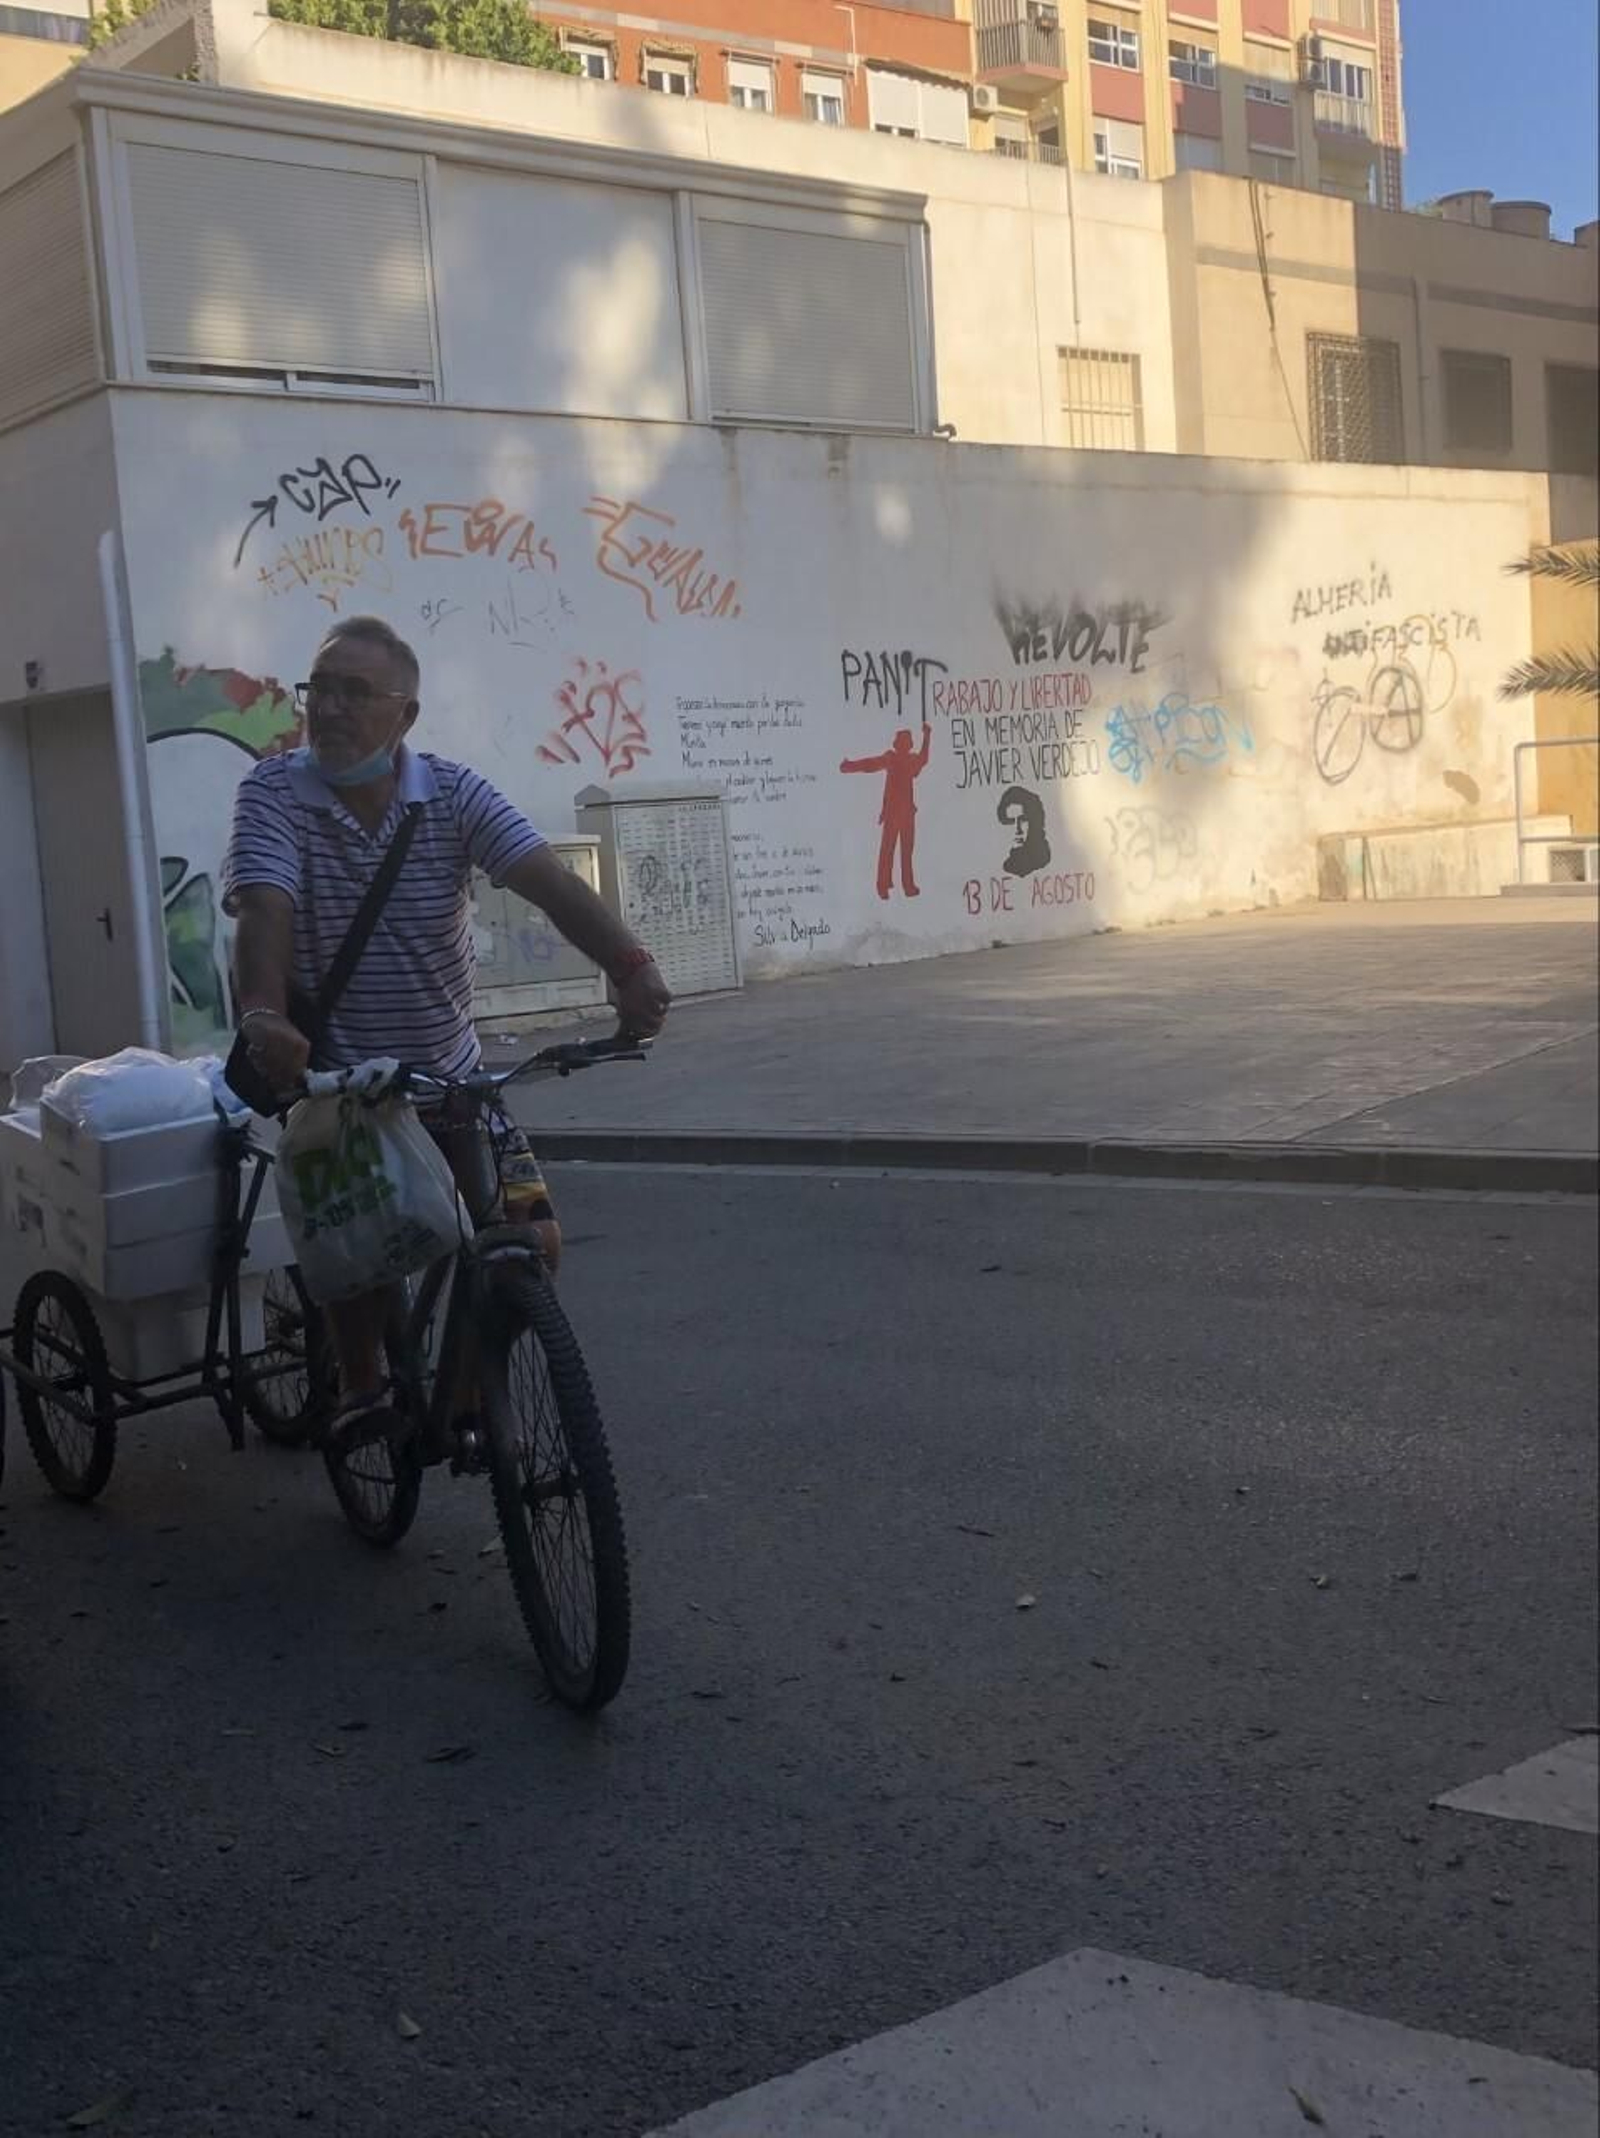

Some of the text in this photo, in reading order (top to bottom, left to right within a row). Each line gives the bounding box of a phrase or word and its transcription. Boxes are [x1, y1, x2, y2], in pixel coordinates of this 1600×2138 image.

[1021, 672, 1092, 711] LIBERTAD
[951, 709, 1084, 749] EN MEMORIA DE
[953, 738, 1101, 789] JAVIER VERDEJO
[990, 876, 1014, 912] DE
[1031, 872, 1095, 908] AGOSTO
